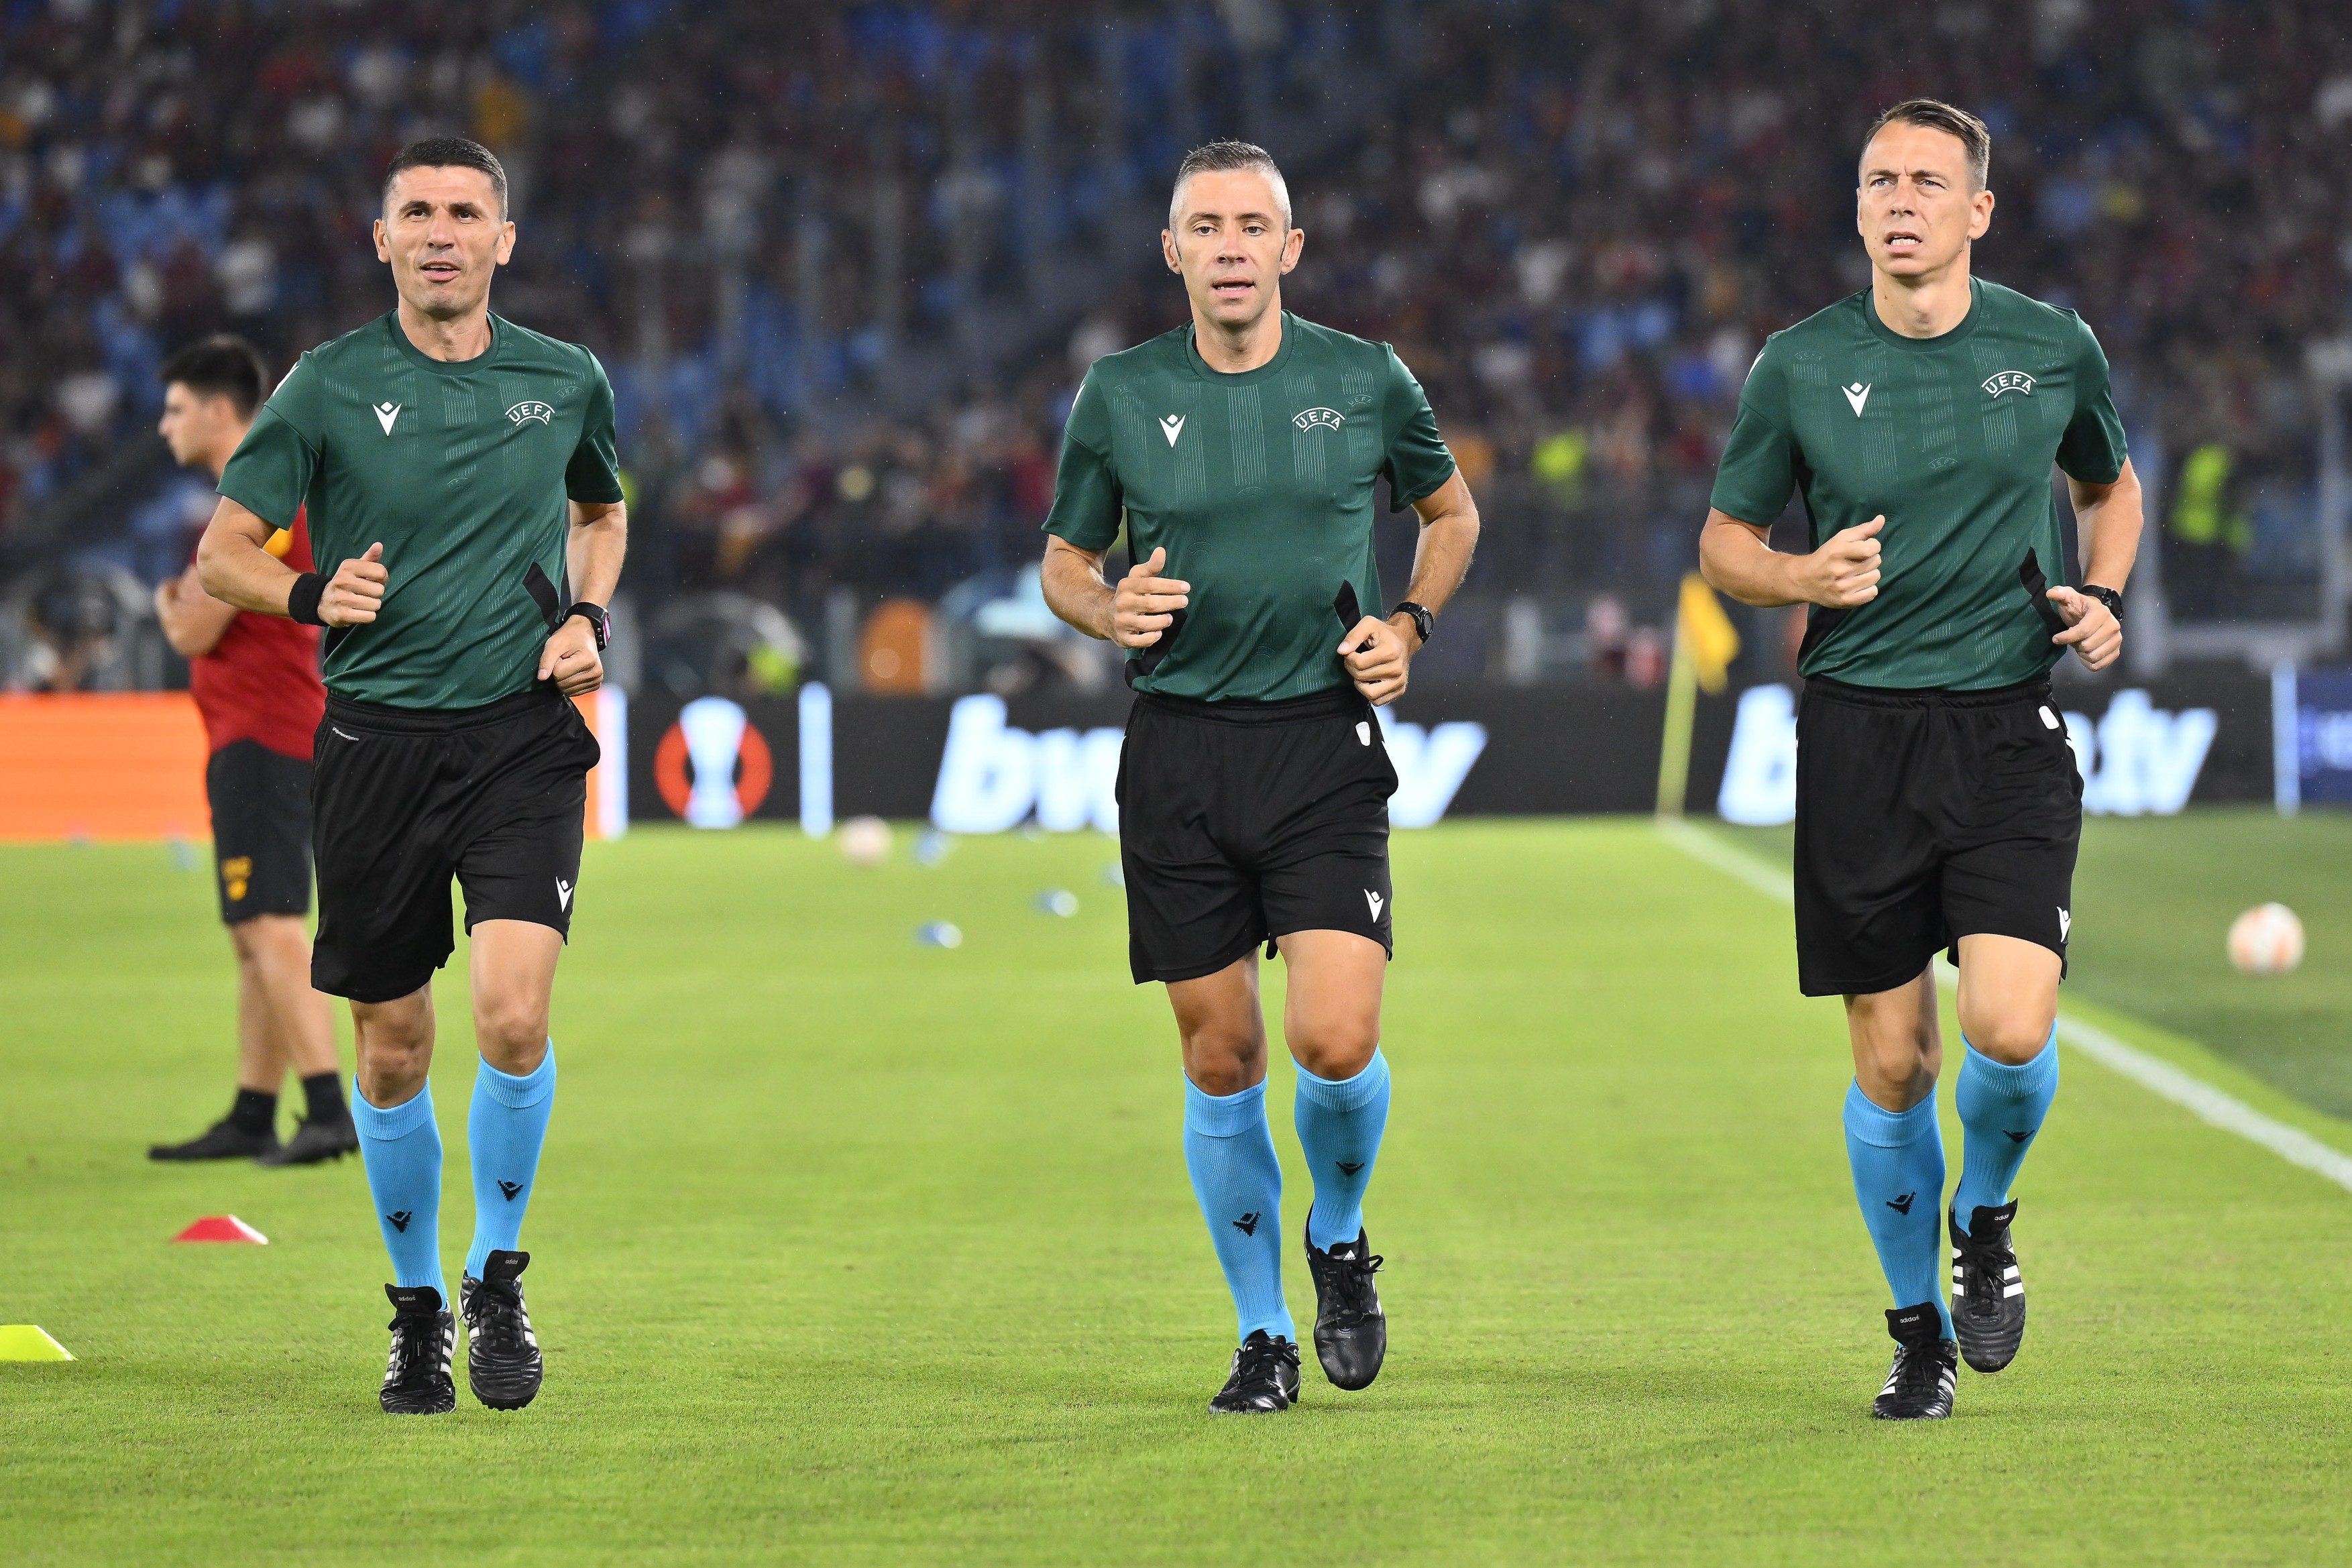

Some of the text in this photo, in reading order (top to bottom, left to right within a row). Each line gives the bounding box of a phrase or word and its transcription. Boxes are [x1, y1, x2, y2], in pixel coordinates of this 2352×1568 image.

[1984, 375, 2031, 394] UEFA
[508, 404, 552, 423] UEFA
[1295, 411, 1340, 429] UEFA
